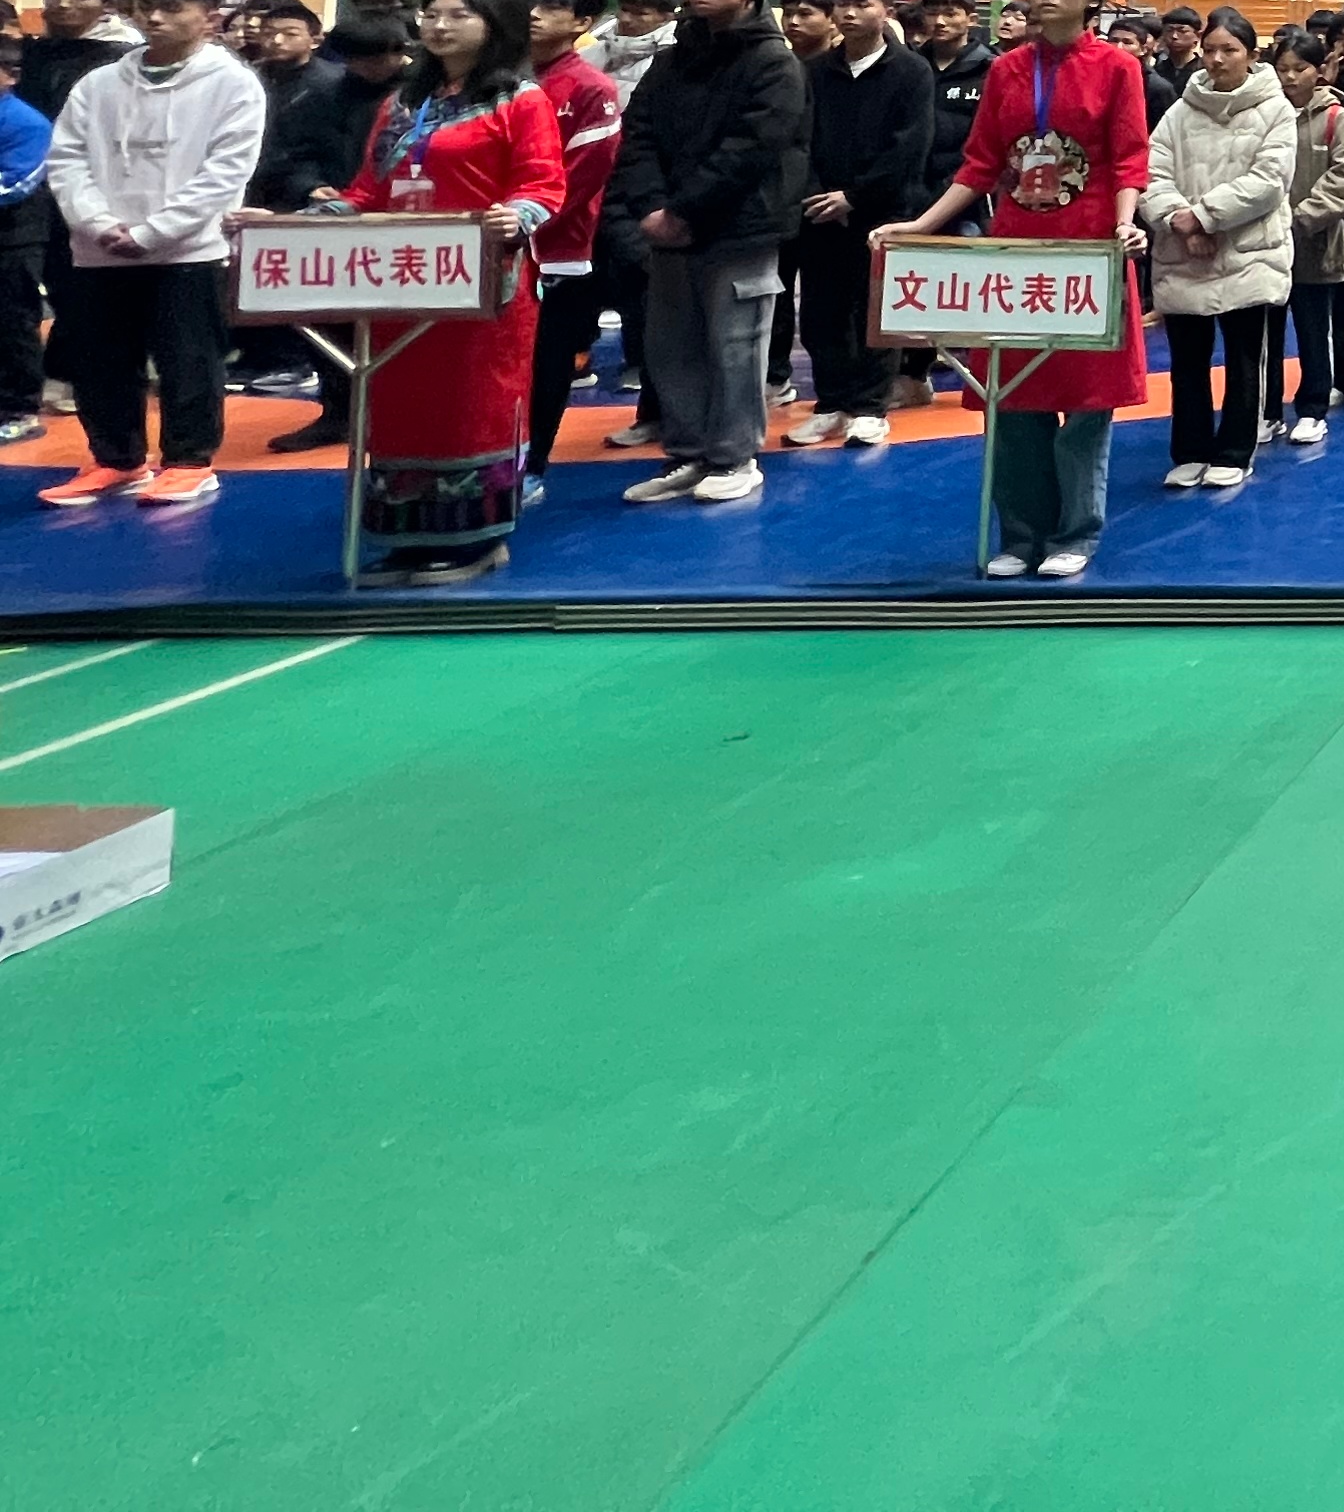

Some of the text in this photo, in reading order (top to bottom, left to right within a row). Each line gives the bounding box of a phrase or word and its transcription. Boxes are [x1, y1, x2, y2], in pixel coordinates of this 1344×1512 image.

[252, 243, 473, 289] 保山代表队
[891, 270, 1100, 316] 文山代表队
